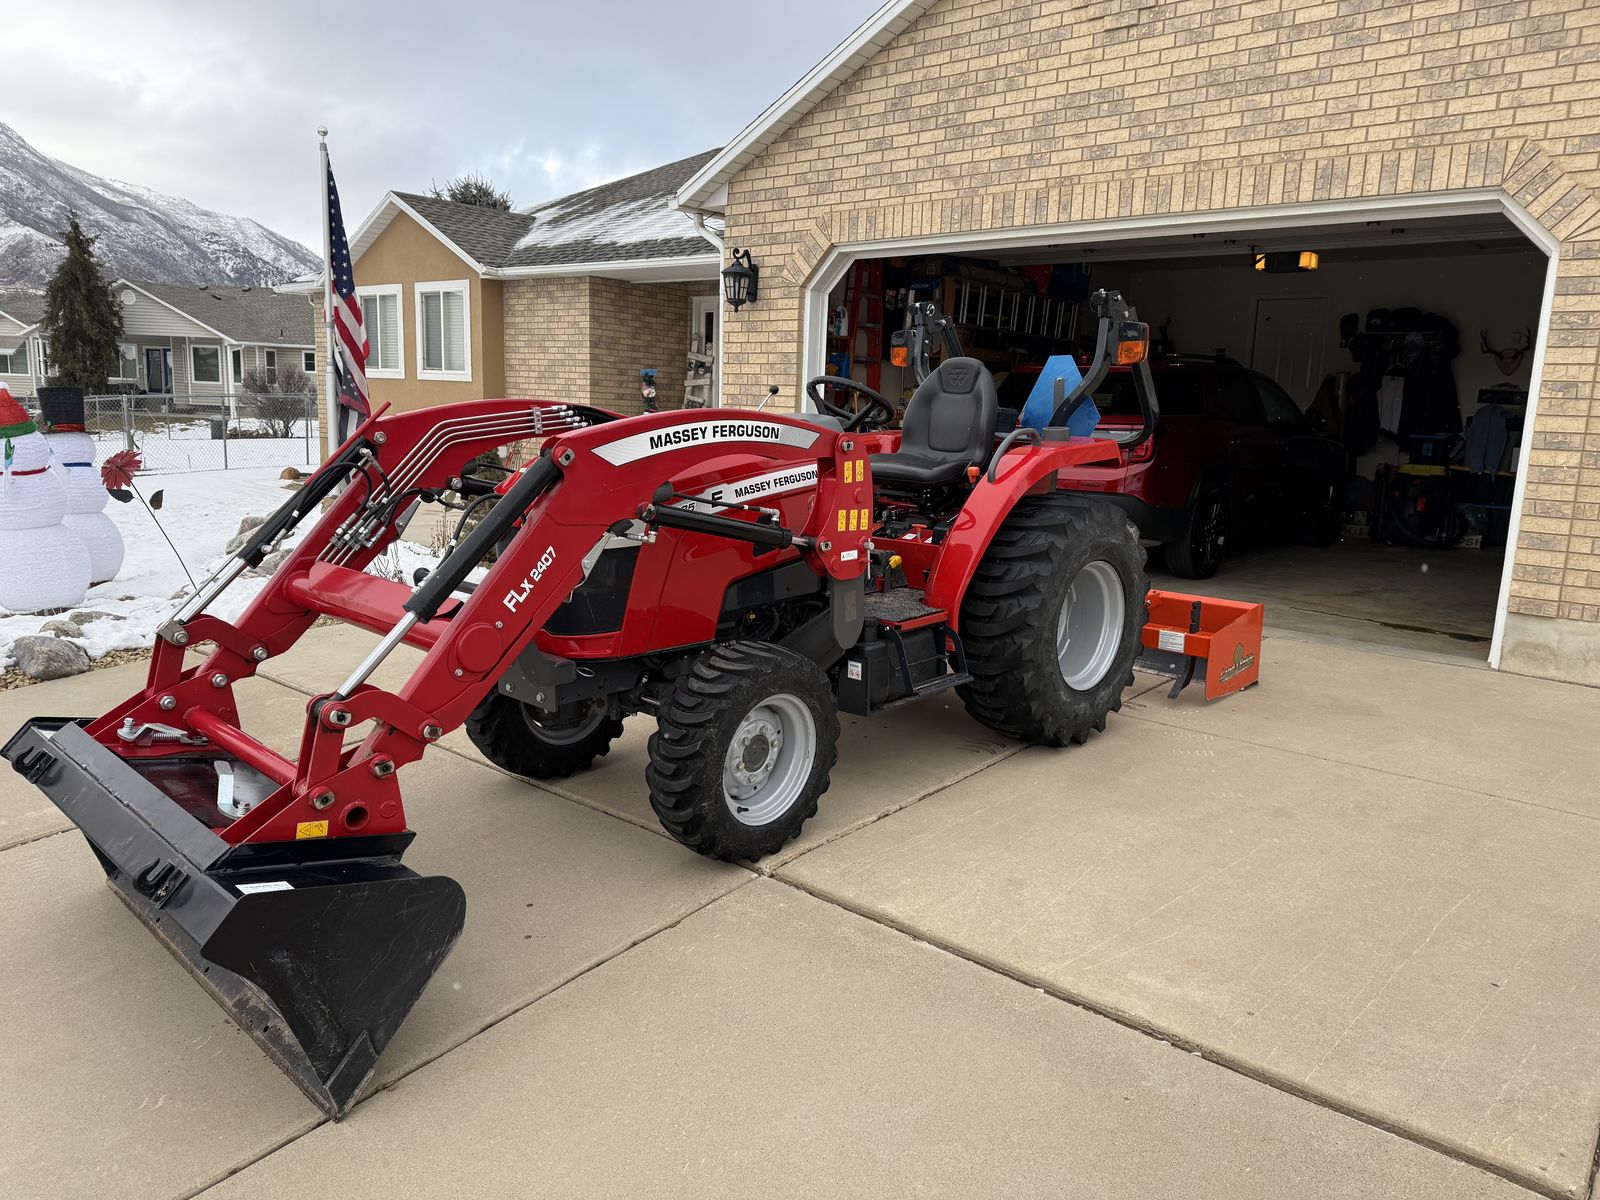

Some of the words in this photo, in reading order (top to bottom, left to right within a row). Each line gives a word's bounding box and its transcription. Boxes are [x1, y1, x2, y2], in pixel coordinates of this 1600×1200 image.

[649, 426, 708, 450] MASSEY
[712, 424, 780, 440] FERGUSON
[734, 480, 771, 499] MASSEY
[773, 470, 818, 488] FERGUSON
[502, 578, 535, 613] FLX
[529, 545, 557, 582] 2407
